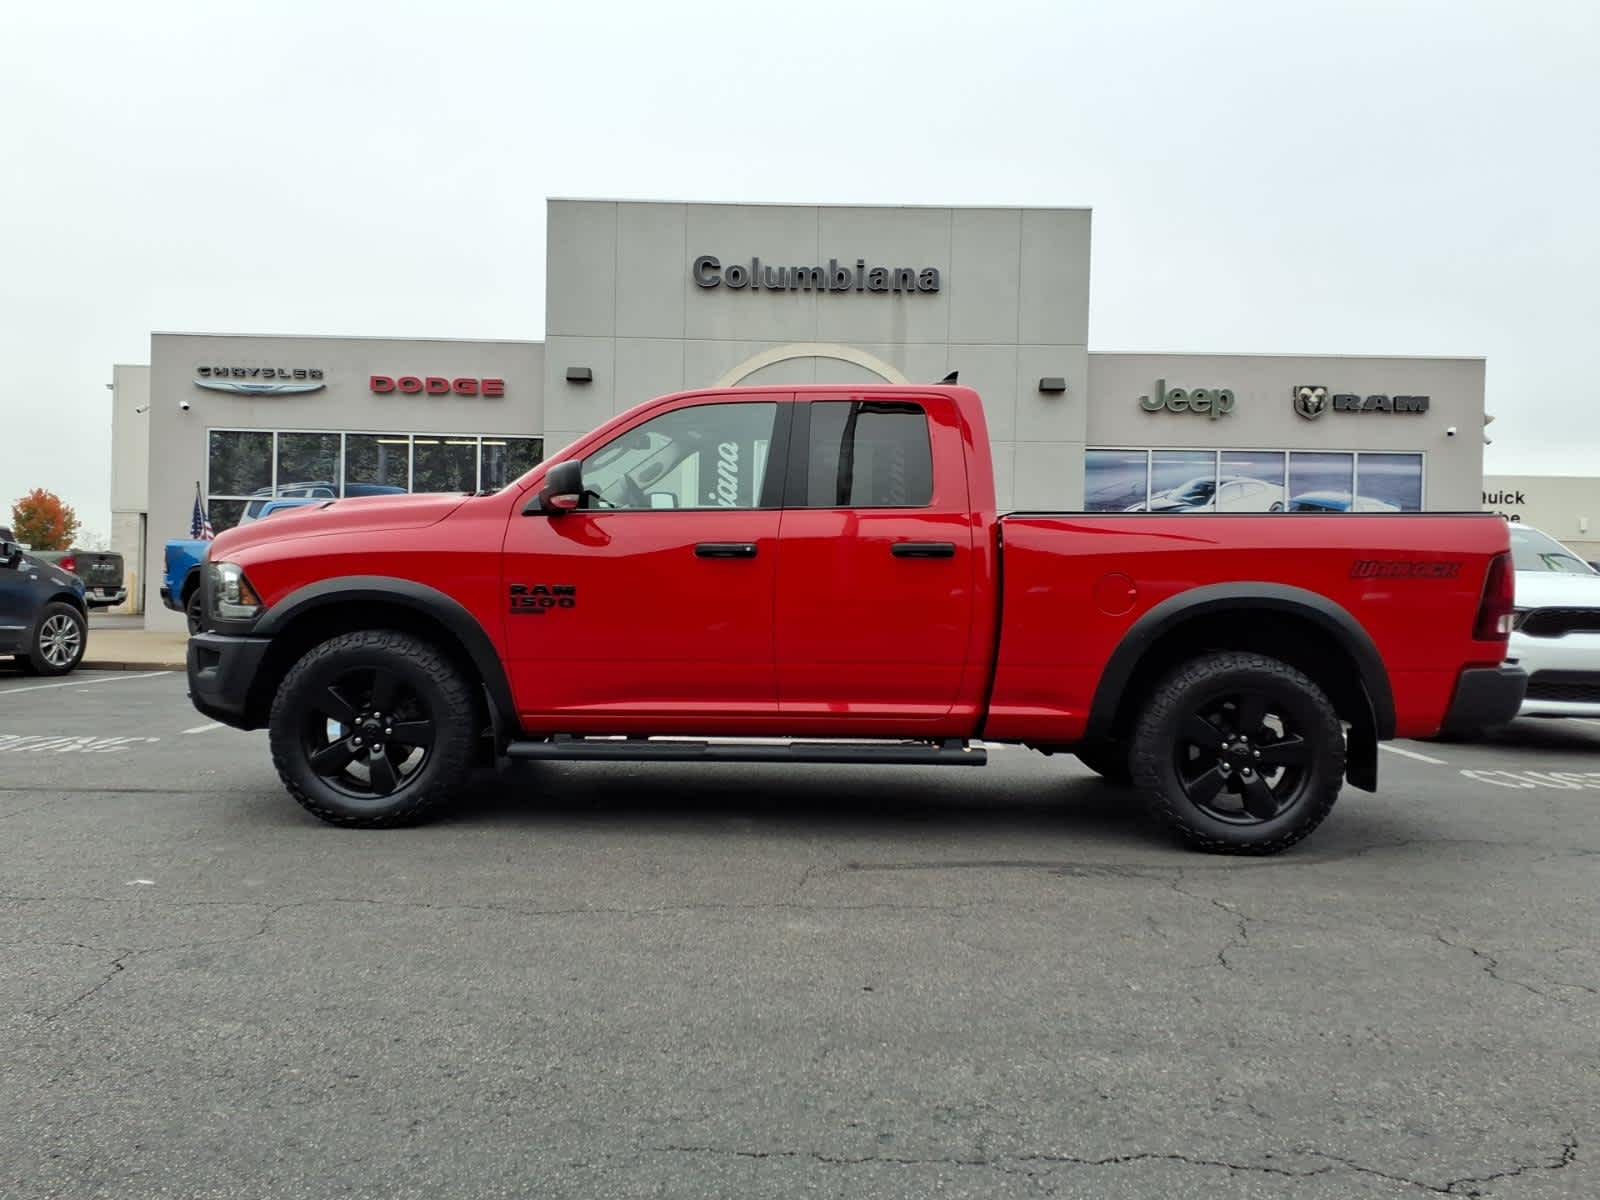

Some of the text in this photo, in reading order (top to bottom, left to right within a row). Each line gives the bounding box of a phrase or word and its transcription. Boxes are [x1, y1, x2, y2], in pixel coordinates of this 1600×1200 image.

[693, 255, 939, 292] Columbiana
[197, 367, 324, 380] CHRYSLER
[370, 375, 504, 398] DODGE
[1139, 379, 1235, 420] Jeep
[1333, 394, 1430, 414] RAM
[510, 584, 576, 595] RAM
[510, 596, 575, 608] 1500
